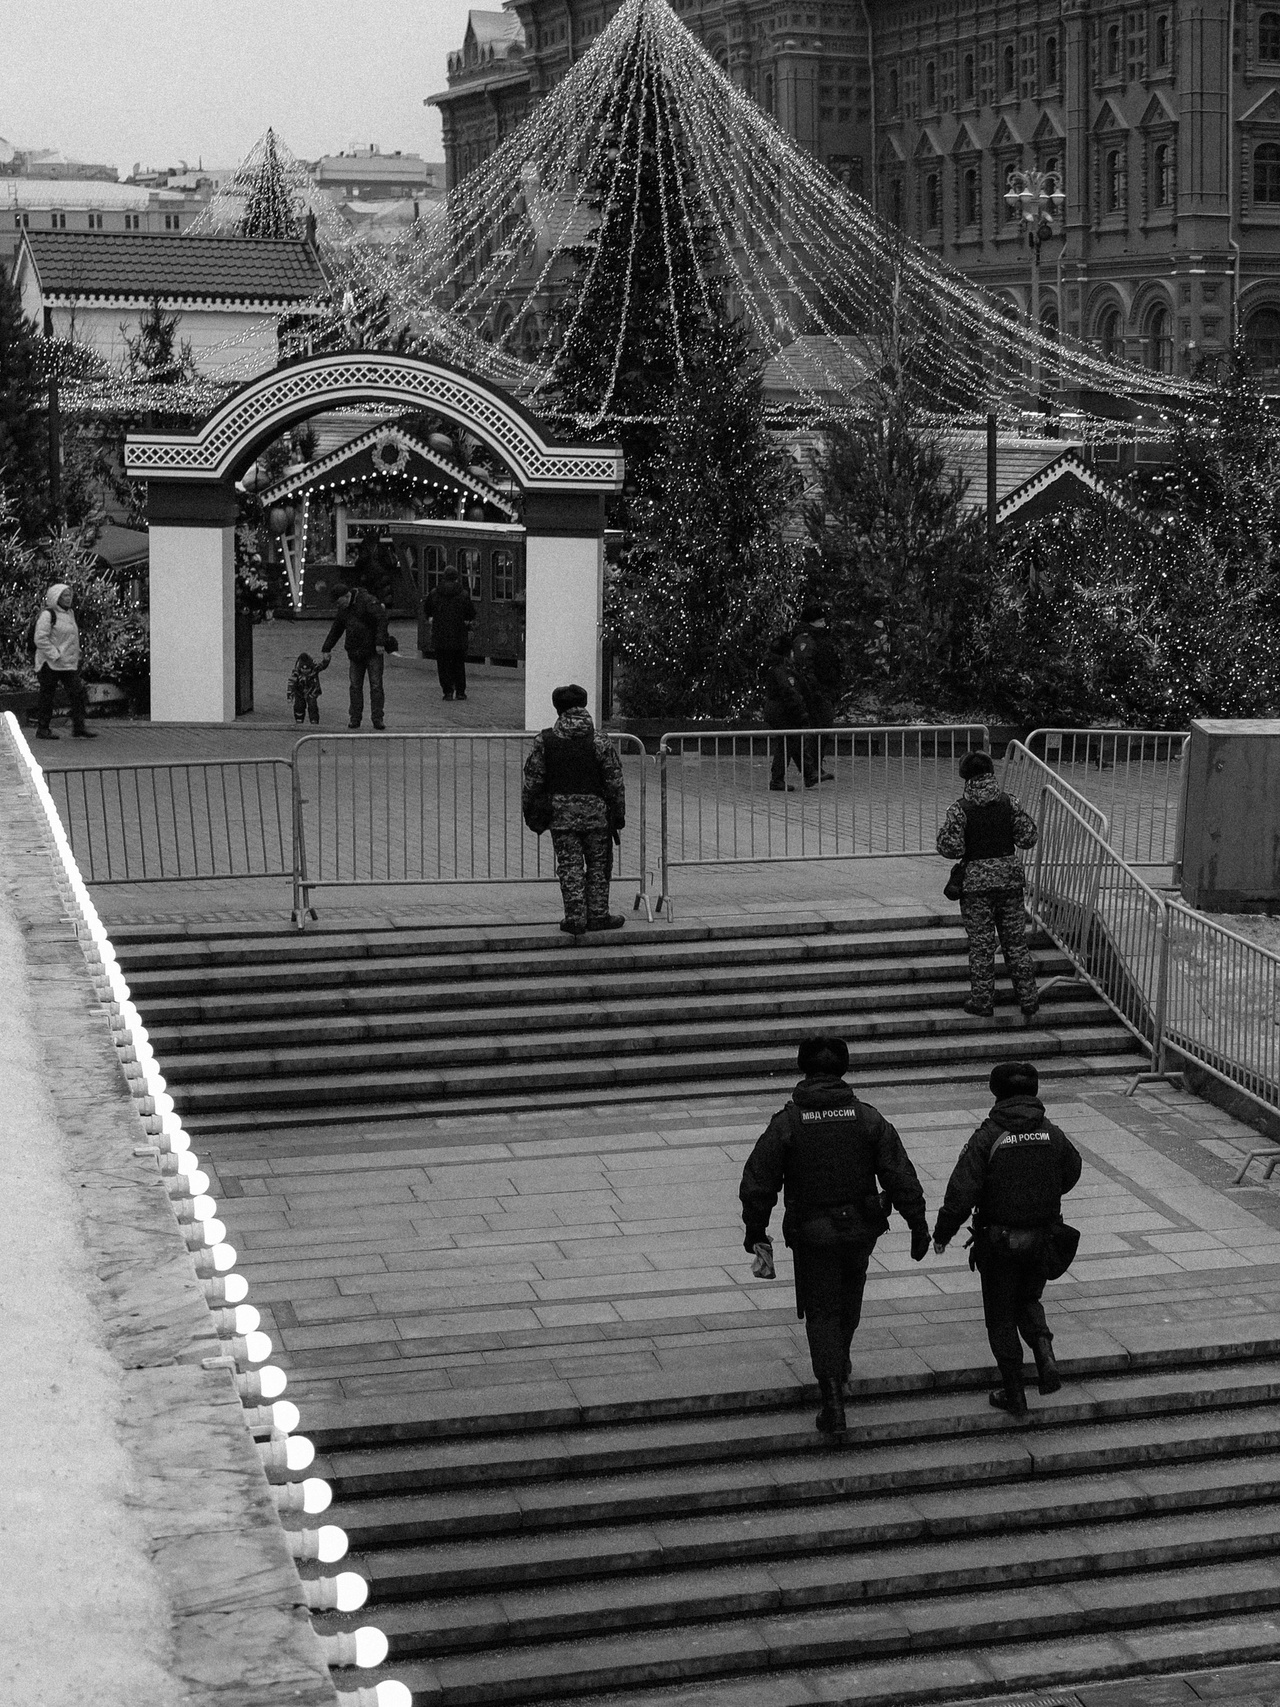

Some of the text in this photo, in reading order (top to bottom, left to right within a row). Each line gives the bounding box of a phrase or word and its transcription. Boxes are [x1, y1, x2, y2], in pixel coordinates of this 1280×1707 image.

[802, 1109, 856, 1120] МВД РОССИИ
[1018, 1132, 1051, 1142] РОССИИ
